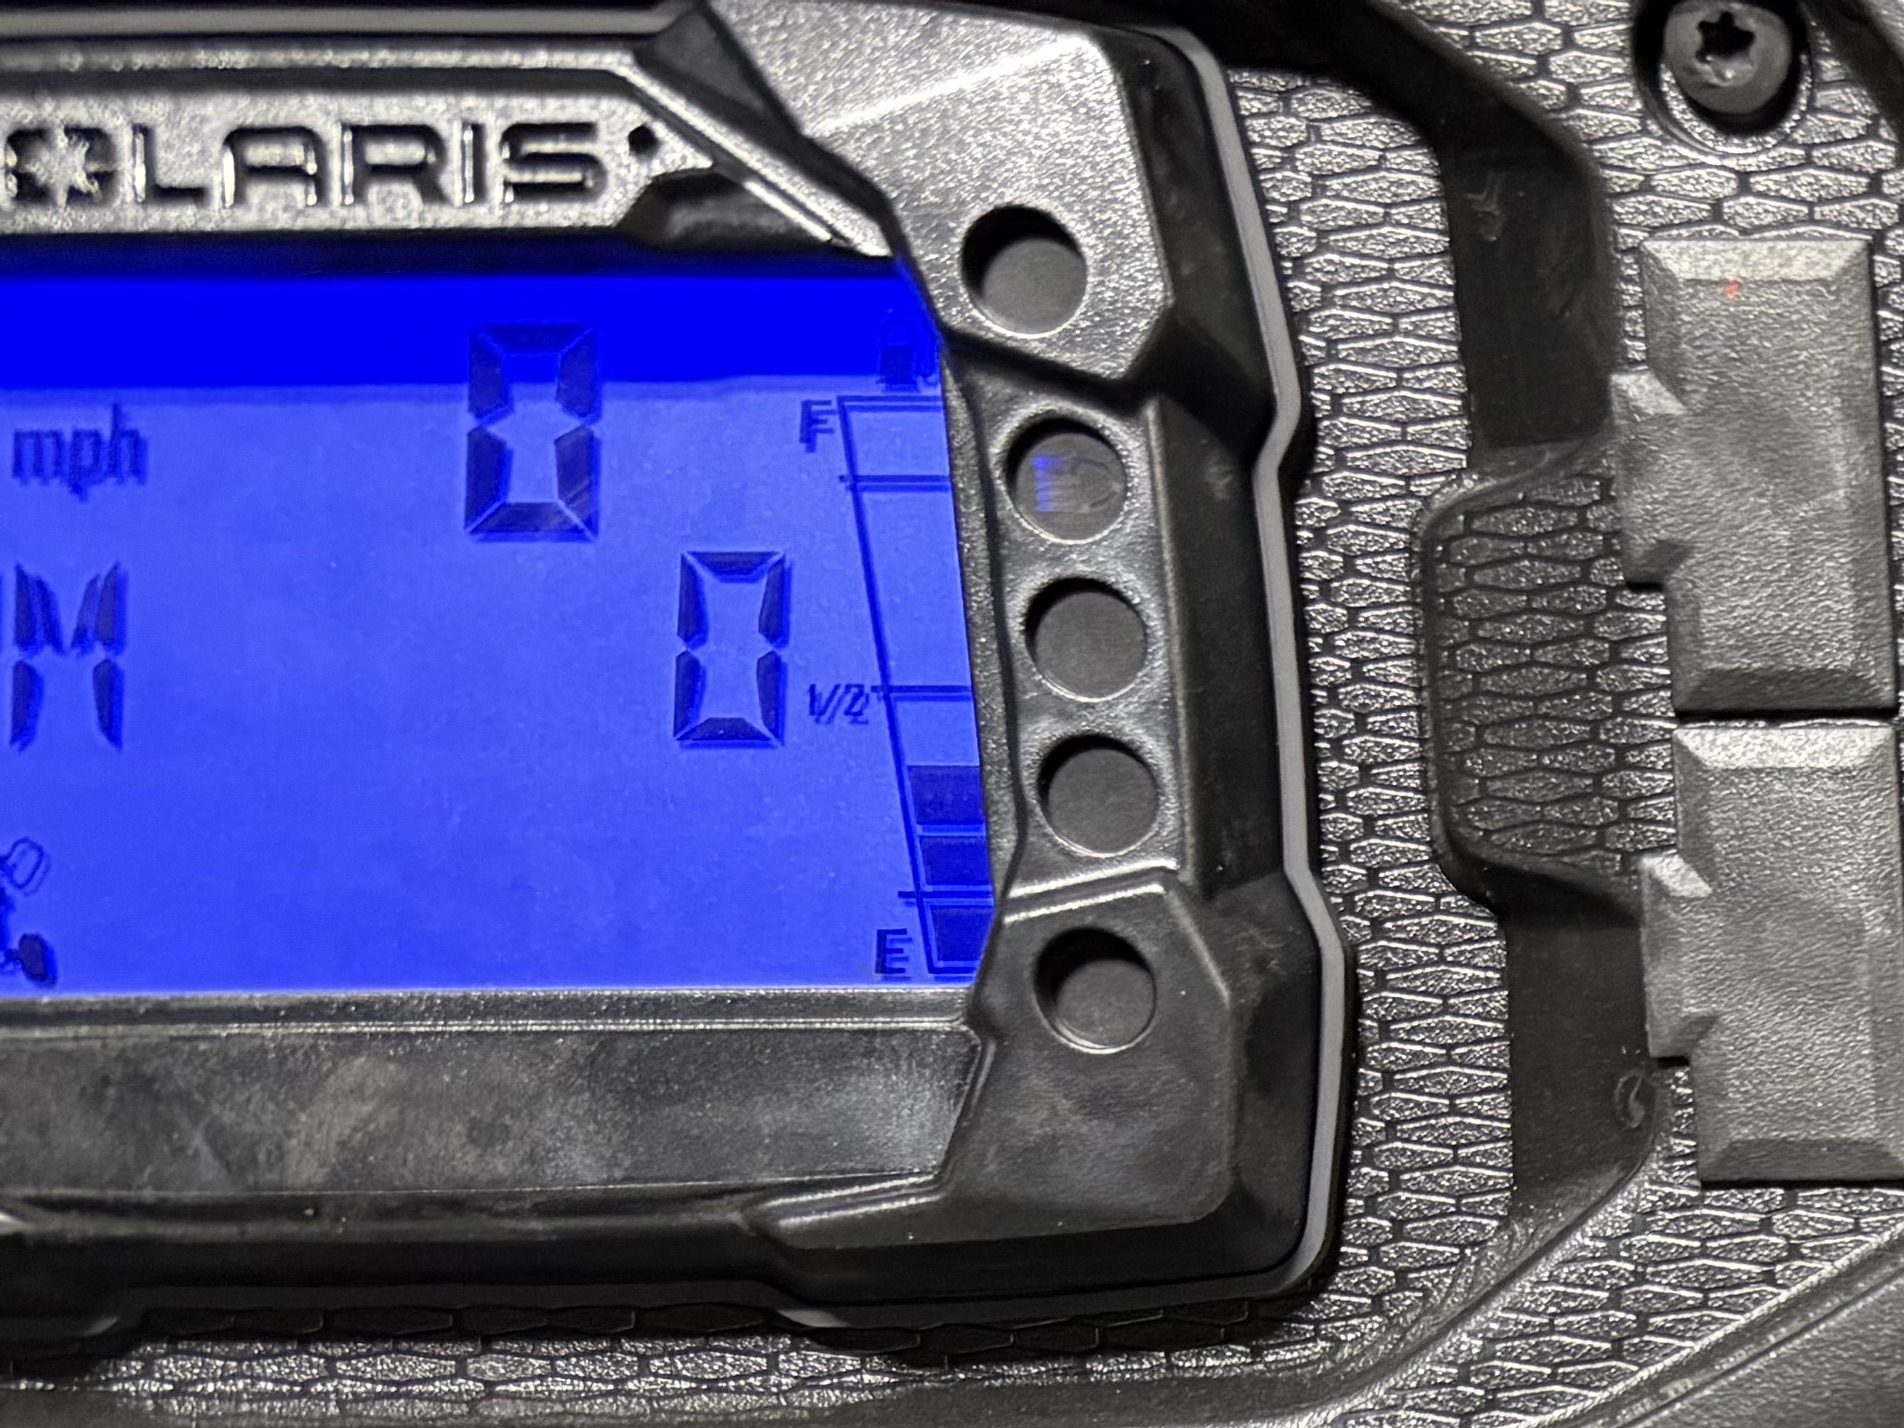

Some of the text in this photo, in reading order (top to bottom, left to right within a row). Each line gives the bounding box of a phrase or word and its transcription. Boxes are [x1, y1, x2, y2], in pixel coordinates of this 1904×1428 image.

[11, 405, 146, 498] mph
[465, 322, 602, 542] 0
[800, 399, 837, 453] F
[673, 550, 790, 749] 0
[808, 684, 869, 724] 1/2
[875, 927, 911, 975] E
